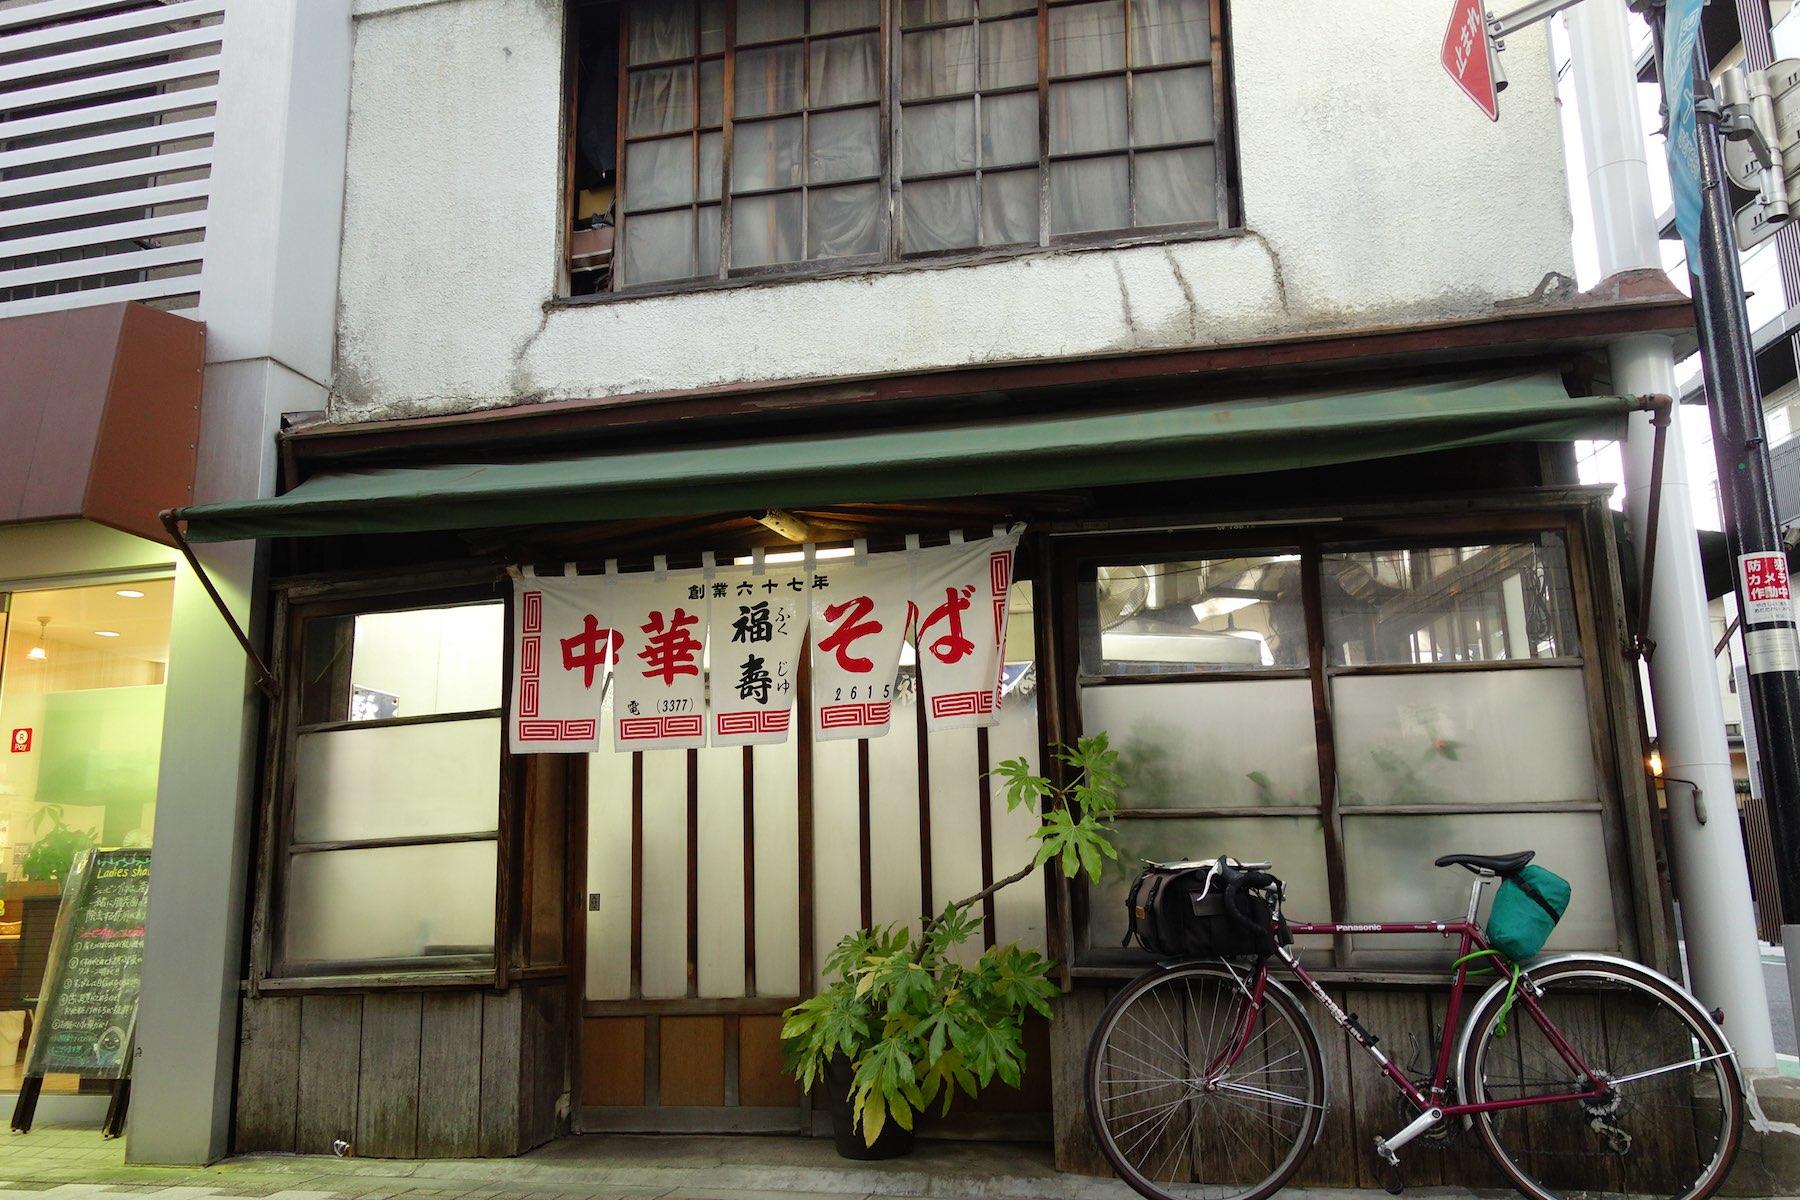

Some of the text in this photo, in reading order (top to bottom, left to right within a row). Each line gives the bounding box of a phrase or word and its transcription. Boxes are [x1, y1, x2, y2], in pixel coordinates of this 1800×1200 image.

[1455, 7, 1480, 79] 止まれ
[1747, 558, 1785, 573] 防犯
[1748, 572, 1786, 586] カメラ
[688, 575, 829, 600] 創業六十七年
[1751, 585, 1789, 600] 作動中
[656, 697, 693, 714] (3377)
[835, 684, 890, 701] 2615
[97, 866, 130, 879] Ladies
[1336, 924, 1382, 932] Panasonic
